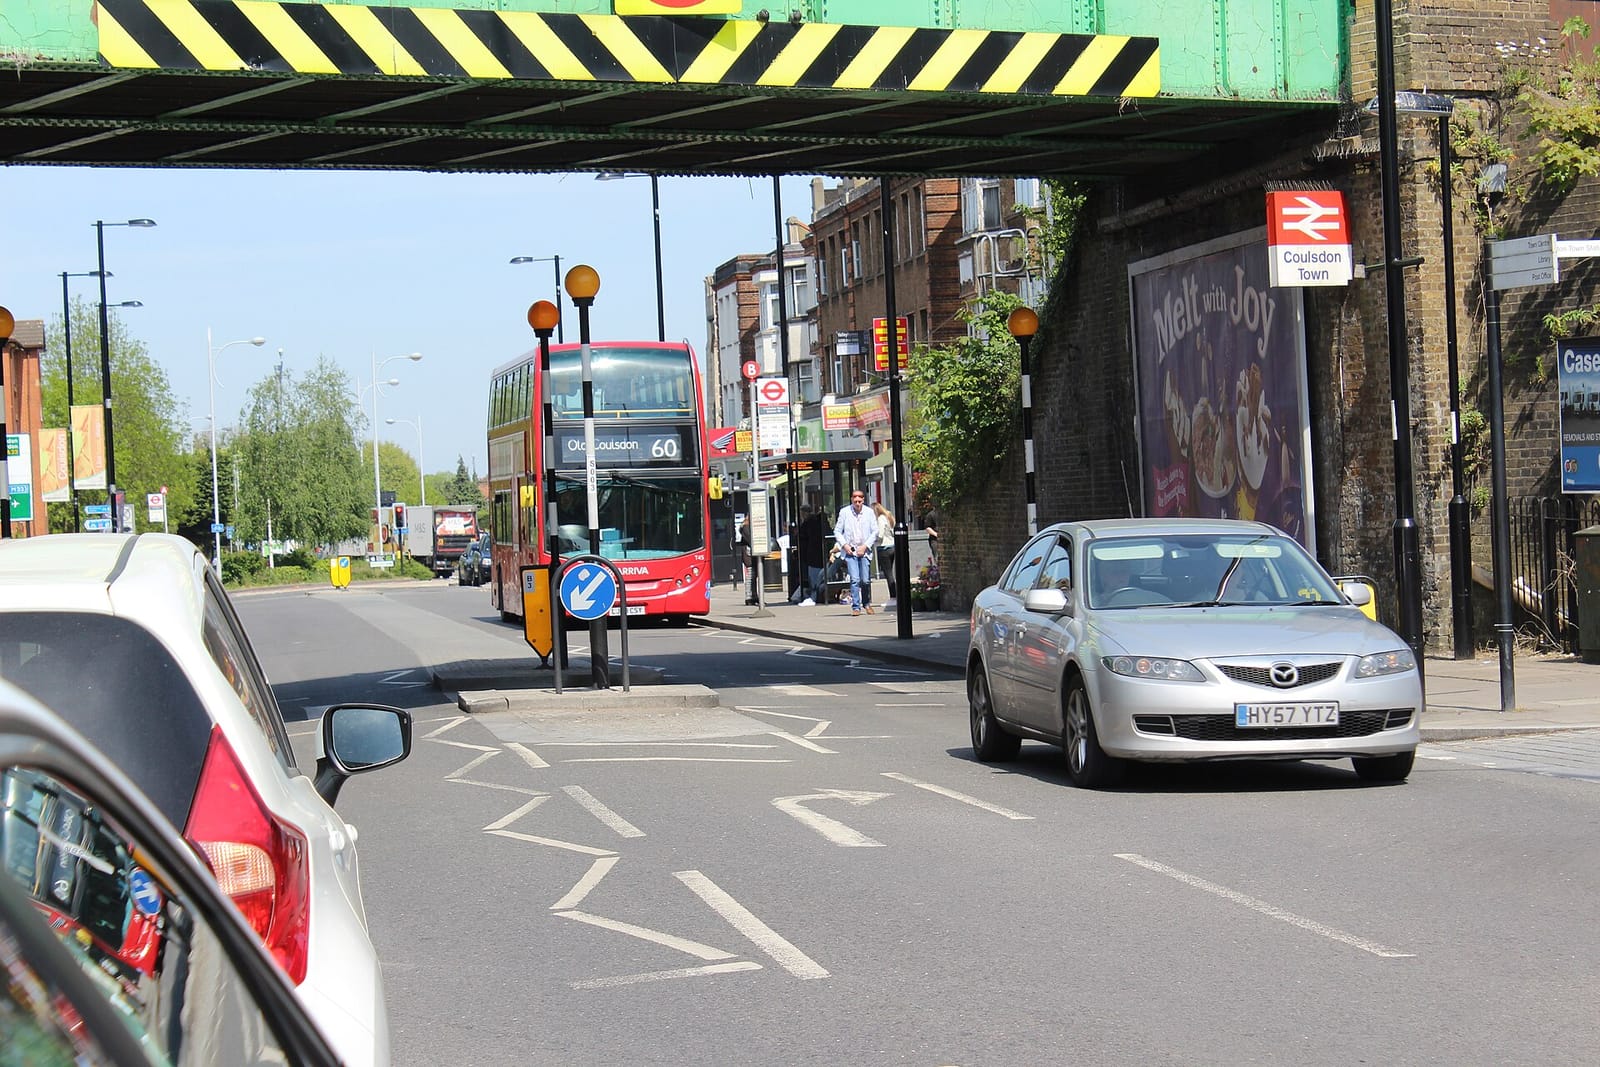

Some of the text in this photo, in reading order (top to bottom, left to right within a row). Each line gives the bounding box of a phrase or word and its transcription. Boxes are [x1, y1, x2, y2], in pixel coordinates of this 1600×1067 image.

[1283, 251, 1342, 264] Coulsdon
[1298, 267, 1329, 280] Town
[1152, 265, 1276, 365] Melt with Joy
[747, 363, 757, 375] B
[1563, 433, 1585, 442] REMOVALS
[651, 438, 677, 458] 60
[618, 566, 649, 575] ARRIVA
[1248, 705, 1337, 724] HY57 YTZ
